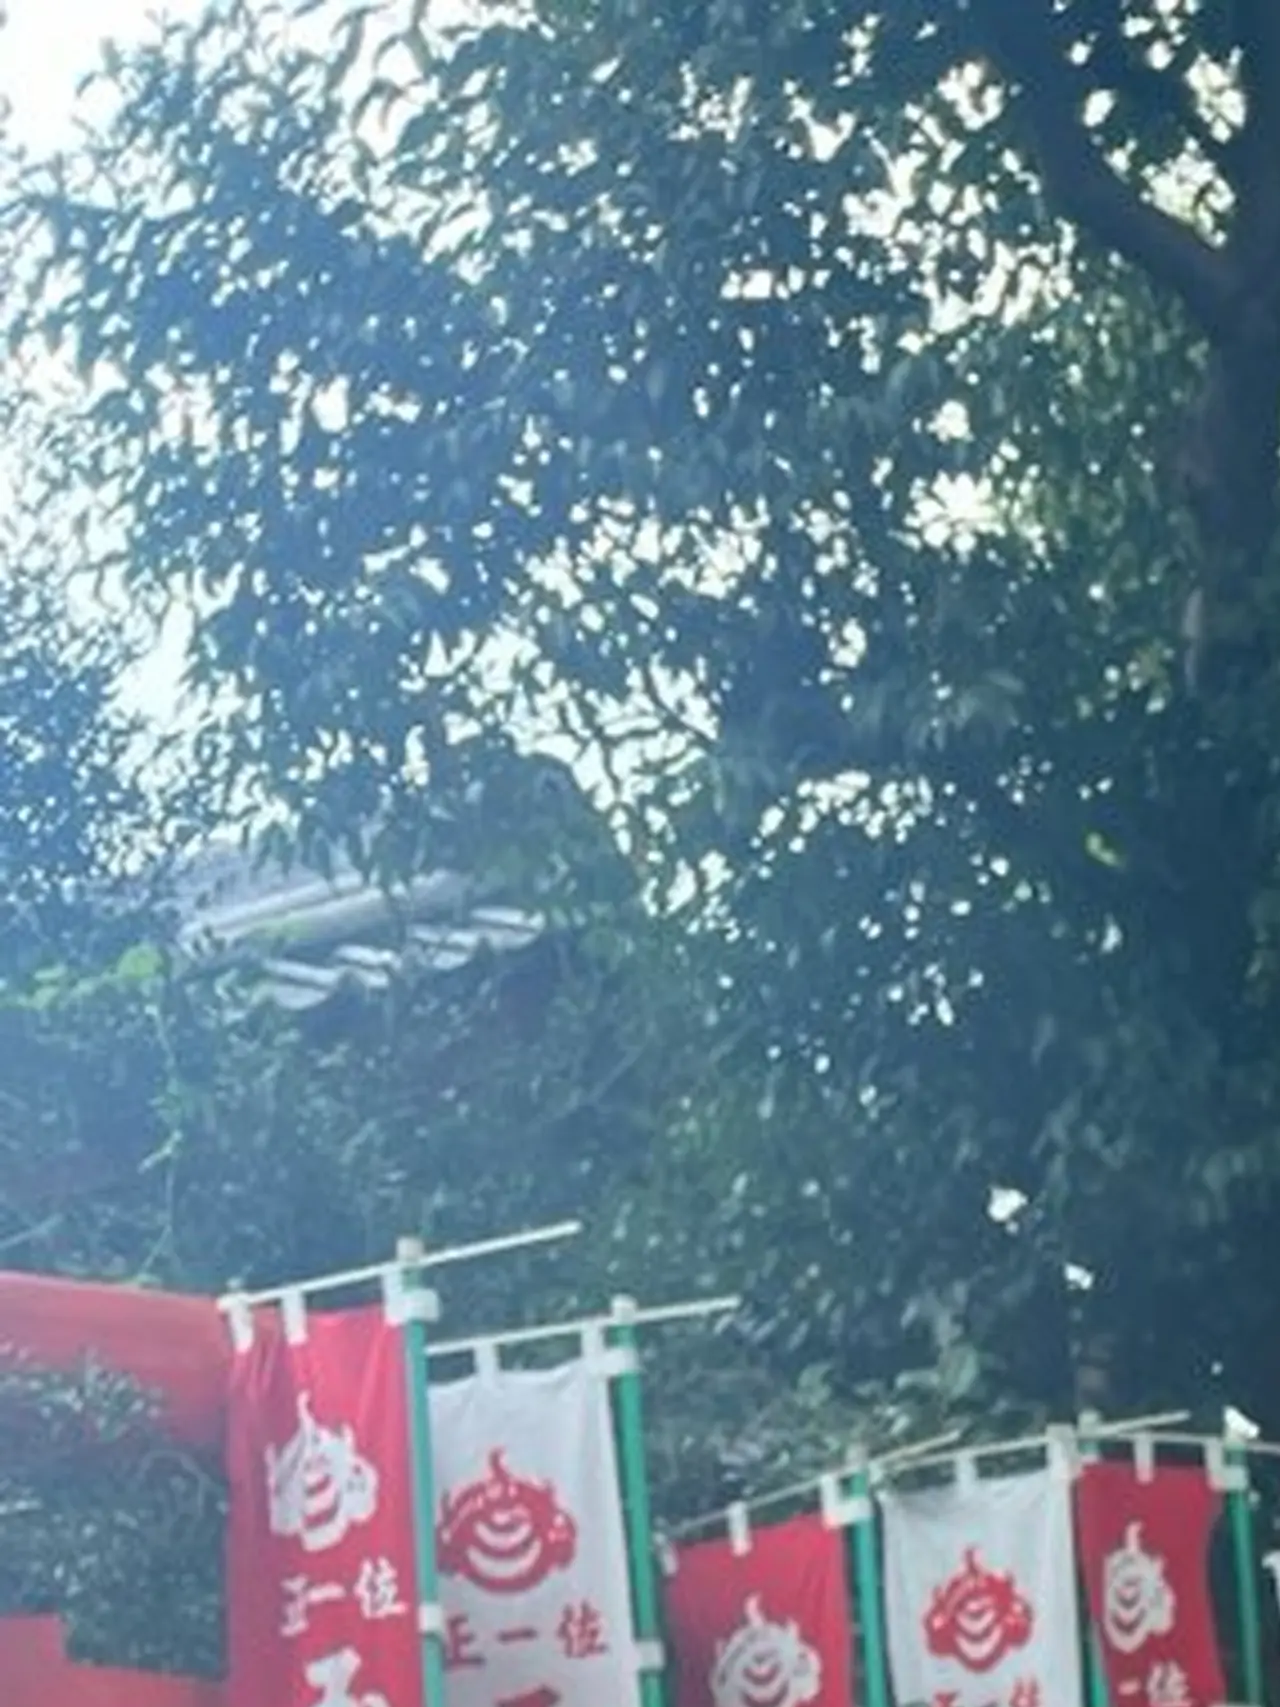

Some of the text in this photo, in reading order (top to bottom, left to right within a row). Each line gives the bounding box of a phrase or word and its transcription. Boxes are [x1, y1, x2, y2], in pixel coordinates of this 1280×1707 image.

[281, 1556, 407, 1637] 正一位
[441, 1599, 608, 1672] 正一位
